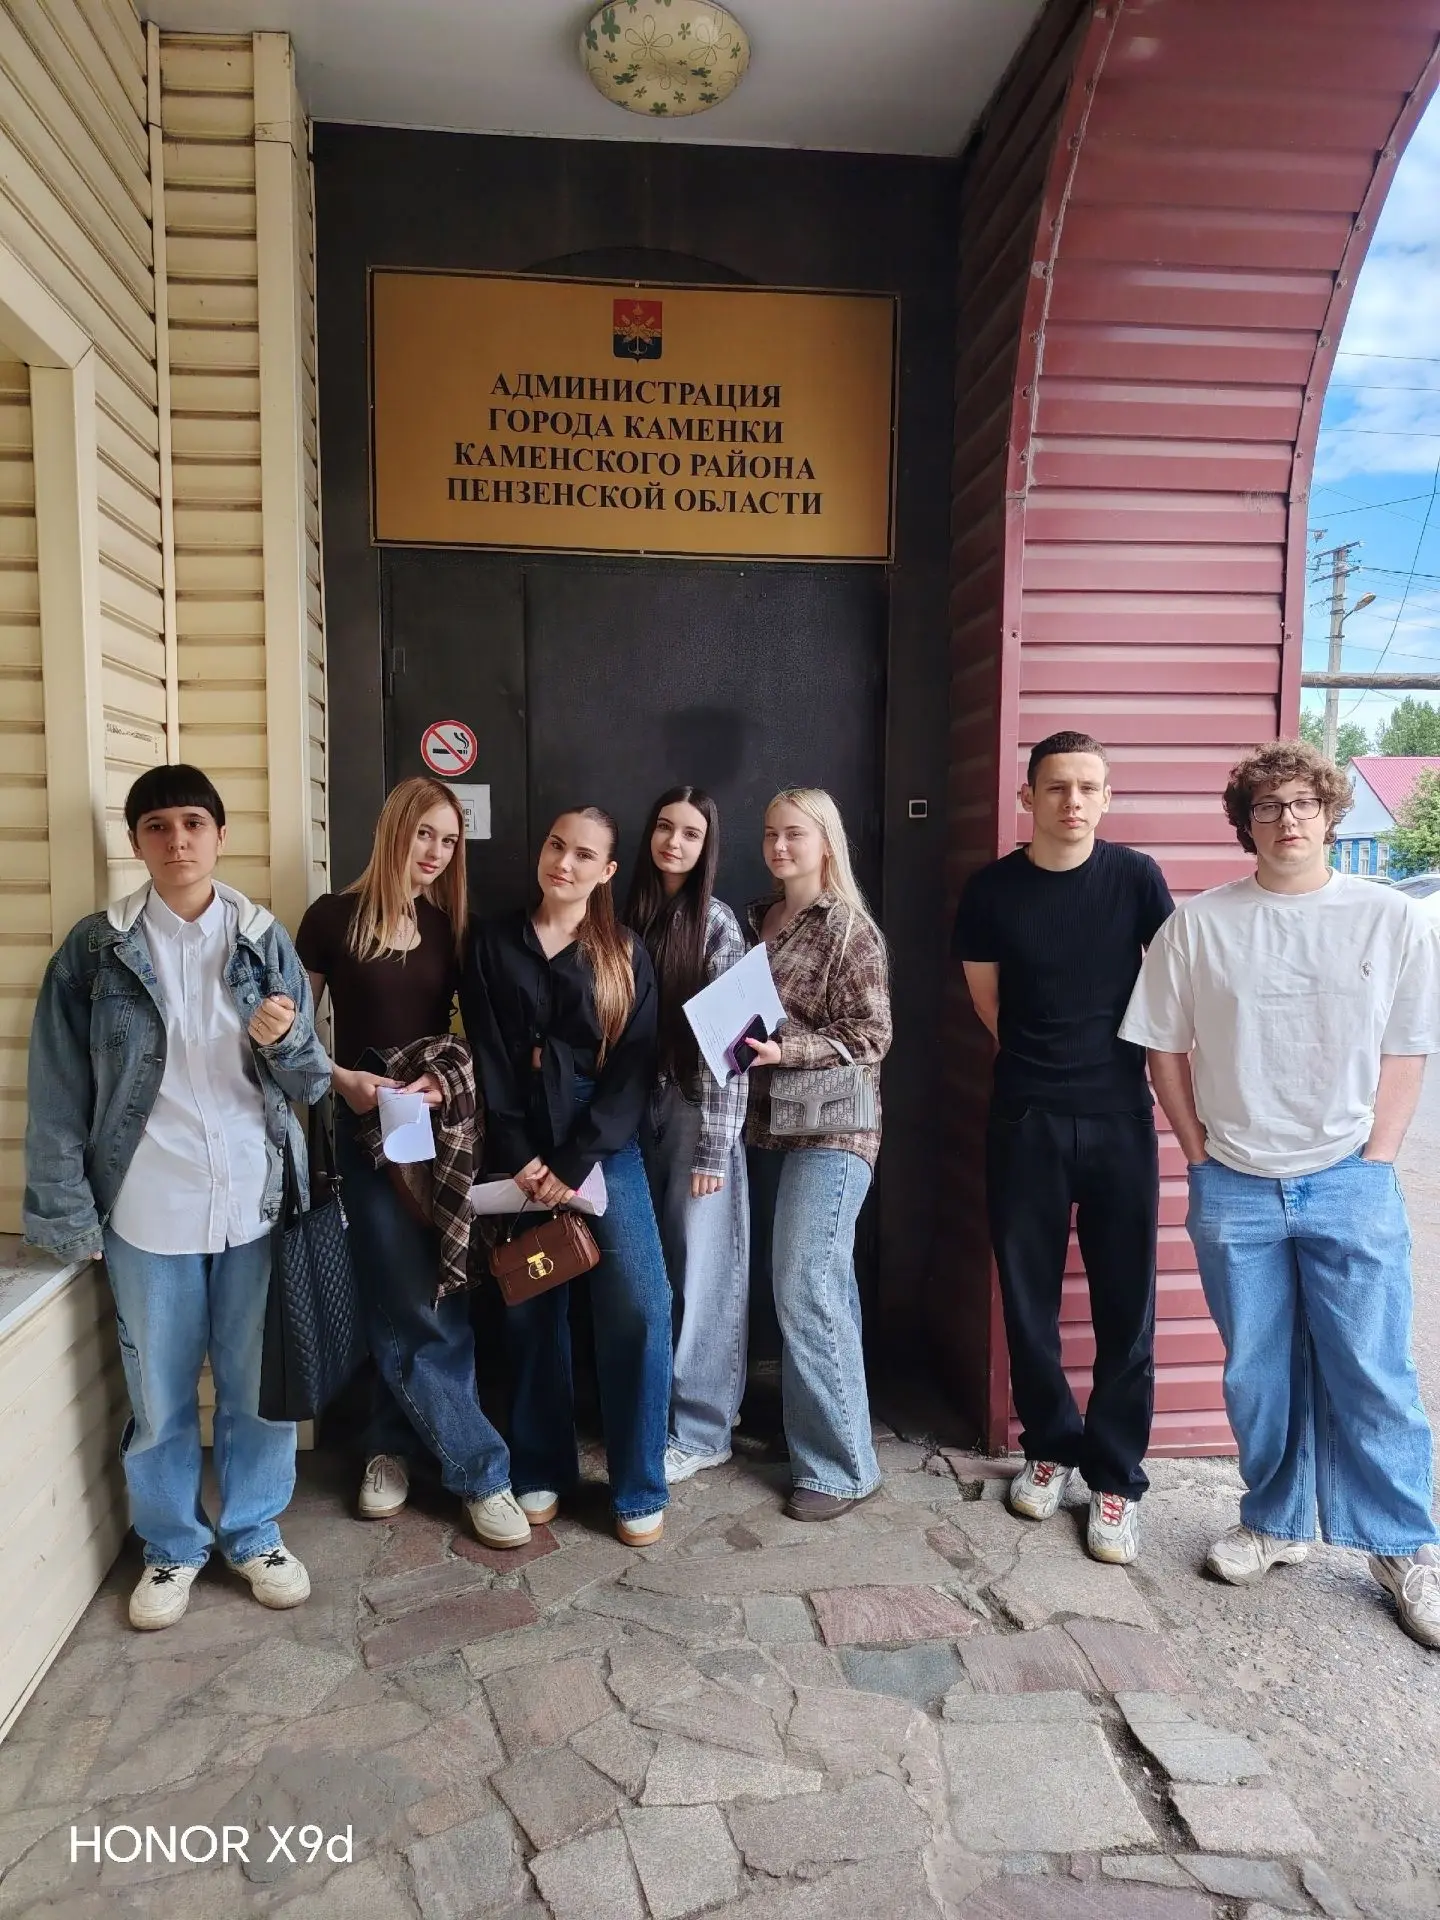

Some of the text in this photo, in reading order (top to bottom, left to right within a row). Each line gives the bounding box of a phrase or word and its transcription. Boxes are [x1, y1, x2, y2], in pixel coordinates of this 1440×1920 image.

[490, 373, 782, 411] АДМИНИСТРАЦИЯ
[488, 408, 784, 443] ГОРОДА КАМЕНКИ
[454, 442, 816, 480] КАМЕНСКОГО РАЙОНА
[447, 477, 823, 515] ПЕНЗЕНСКОЙ ОБЛАСТИ
